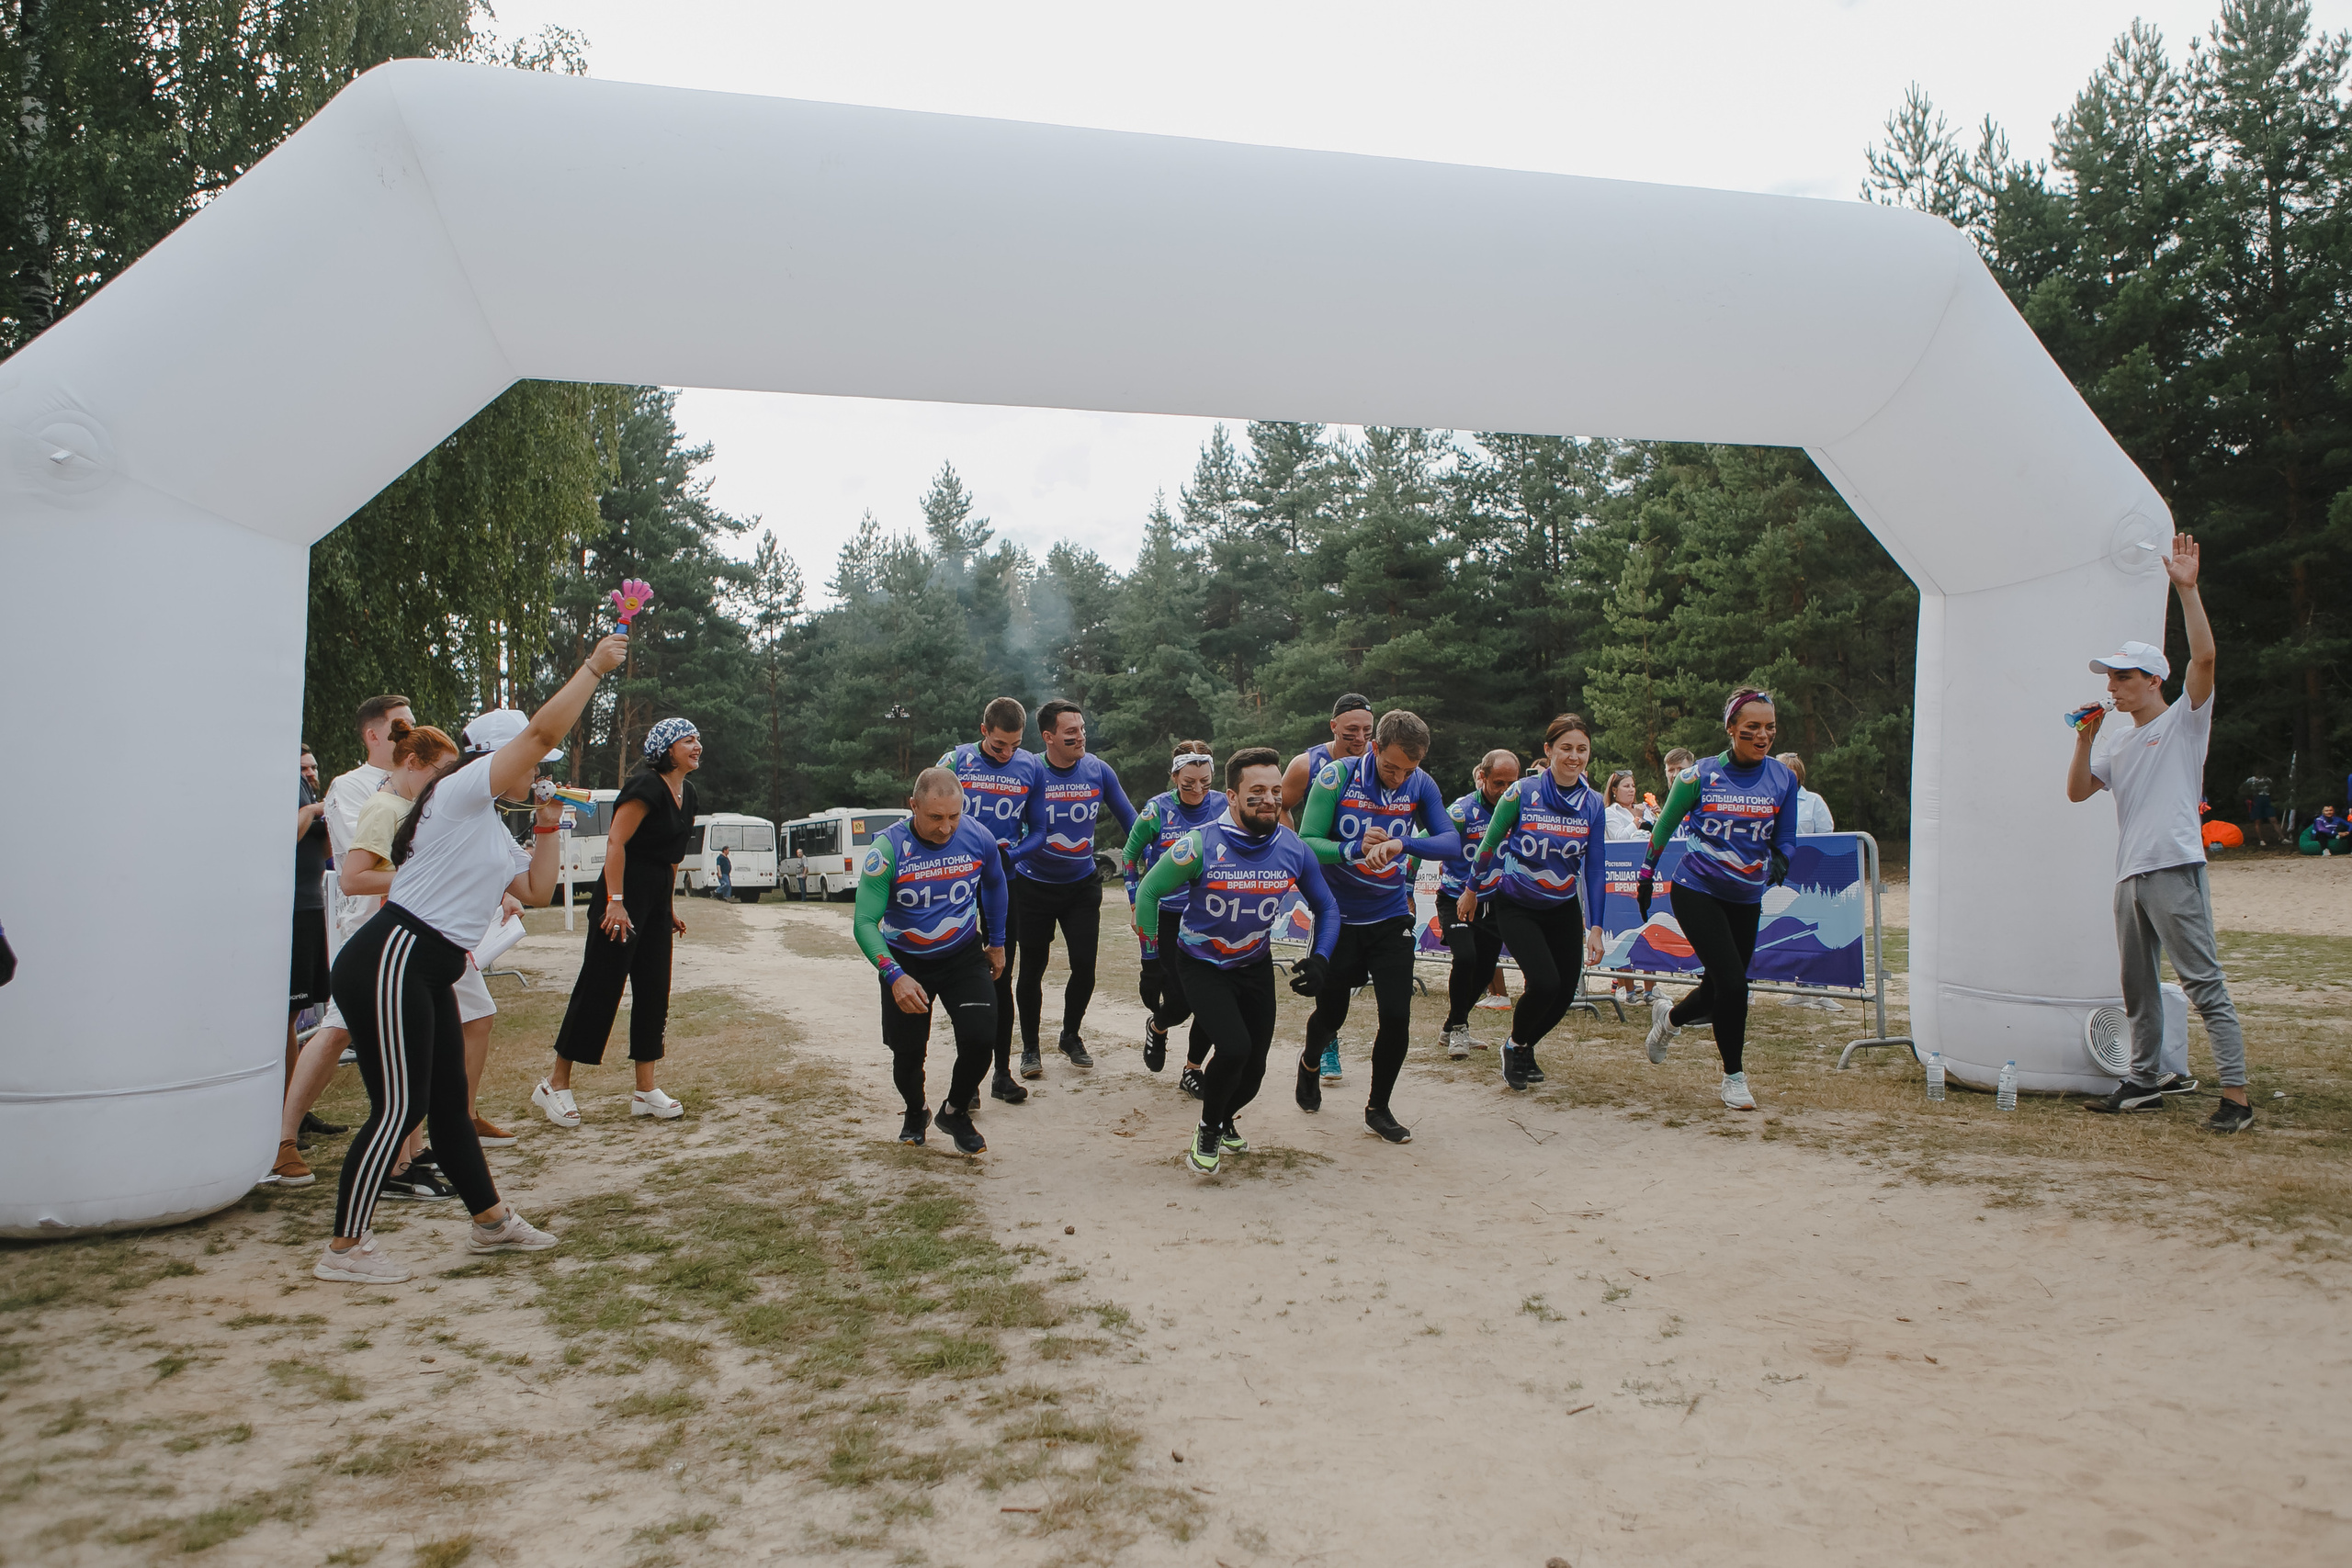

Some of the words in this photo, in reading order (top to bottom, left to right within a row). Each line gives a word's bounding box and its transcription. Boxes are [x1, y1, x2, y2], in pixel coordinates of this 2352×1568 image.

[997, 775, 1021, 785] ГОНКА
[996, 784, 1022, 793] ГЕРОЕВ
[1702, 795, 1744, 803] БОЛЬШАЯ
[1746, 795, 1774, 805] ГОНКА
[1717, 804, 1745, 812] ВРЕМЯ
[1521, 814, 1560, 823] БОЛЬШАЯ
[1562, 818, 1589, 826] ГОНКА
[1537, 823, 1561, 831] ВРЕМЯ
[1562, 826, 1588, 834] ГЕРОЕВ
[1702, 818, 1774, 841] 01-10
[943, 854, 972, 865] ГОНКА
[914, 869, 943, 880] ВРЕМЯ
[944, 863, 974, 874] ГЕРОЕВ
[1207, 870, 1256, 879] БОЛЬШАЯ
[1258, 870, 1288, 879] ГОНКА
[1227, 881, 1257, 889] ВРЕМЯ
[1258, 881, 1289, 889] ГЕРОЕВ
[1614, 883, 1637, 892] ВРЕМЯ
